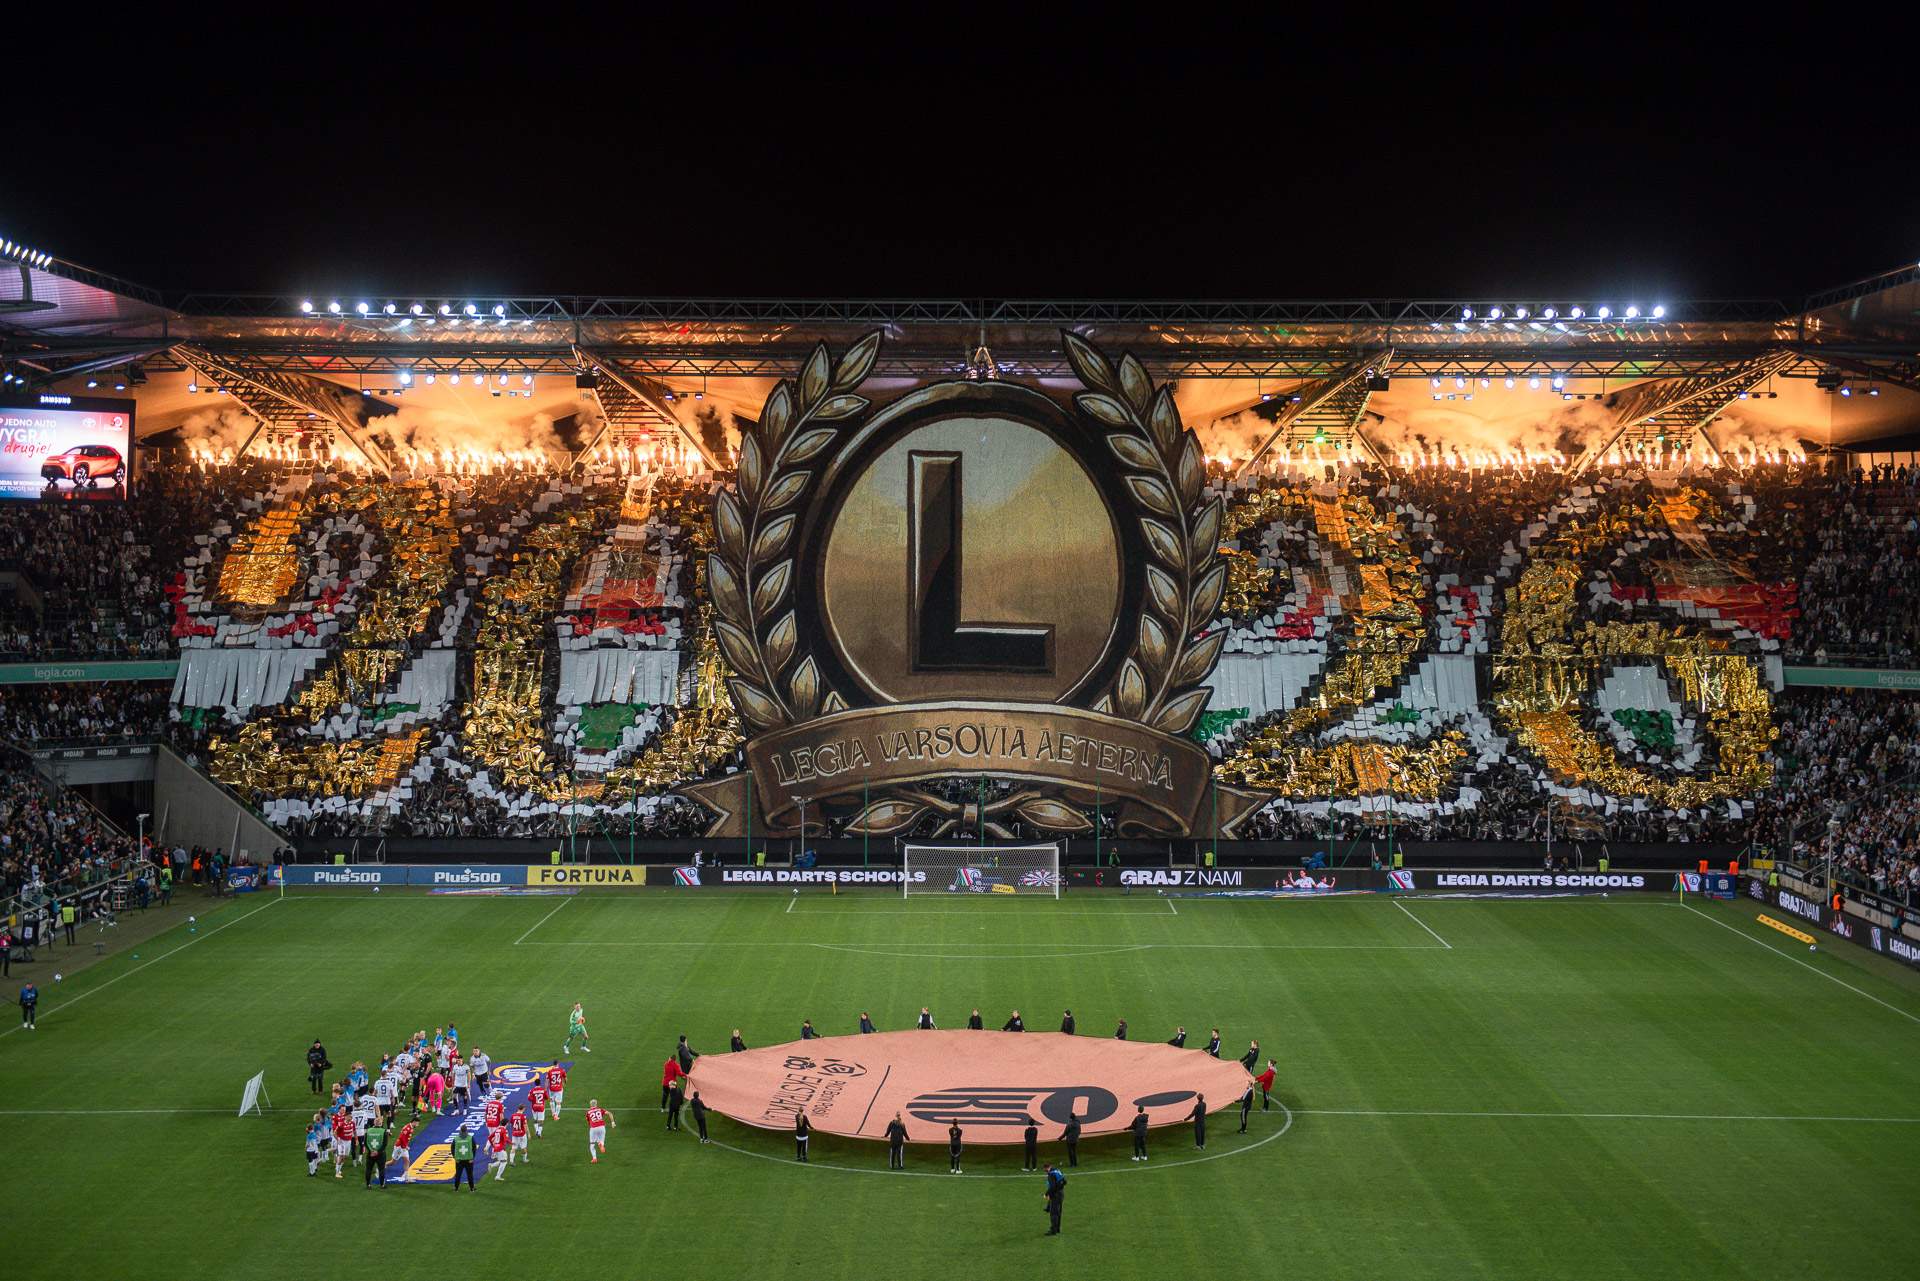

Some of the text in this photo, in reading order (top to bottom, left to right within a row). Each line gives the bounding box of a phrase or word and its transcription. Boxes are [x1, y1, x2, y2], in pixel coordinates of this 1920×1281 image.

[4, 418, 33, 427] JEDNO
[34, 419, 57, 428] AUTO
[907, 450, 1056, 677] L
[34, 667, 85, 681] legia.com
[1878, 673, 1920, 686] legia.co
[771, 723, 1174, 790] LEGIA VARSOVIA AETERNA
[314, 871, 381, 883] Plus500
[434, 871, 501, 883] Plus500
[541, 869, 633, 883] FORTUNA
[723, 871, 926, 882] LEGIA DARTS SCHOOLS
[1120, 870, 1242, 886] GRAJ Z NAMI
[1437, 874, 1645, 888] LEGIA DARTS SCHOOLS
[1779, 891, 1799, 912] GRAJ
[1889, 937, 1911, 959] LEGIA
[550, 1074, 562, 1085] 34
[381, 1085, 387, 1094] 9
[534, 1093, 544, 1104] 12
[363, 1100, 375, 1111] 22
[487, 1107, 498, 1118] 52
[512, 1119, 521, 1131] 41
